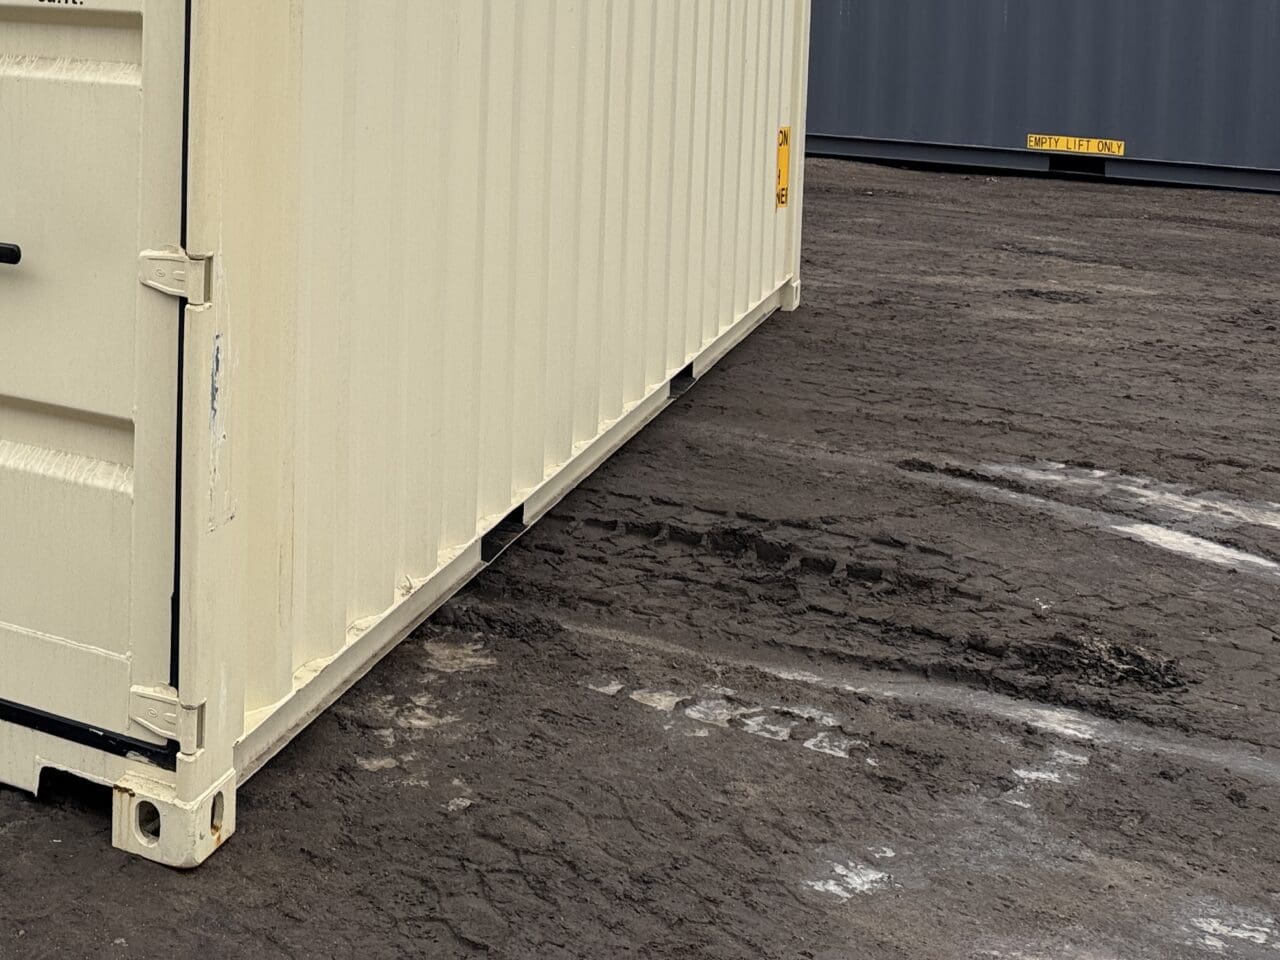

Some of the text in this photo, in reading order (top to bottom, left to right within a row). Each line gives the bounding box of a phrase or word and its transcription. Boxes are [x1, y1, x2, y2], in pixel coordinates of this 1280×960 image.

[1028, 136, 1122, 154] EMPTY LIFT ONLY
